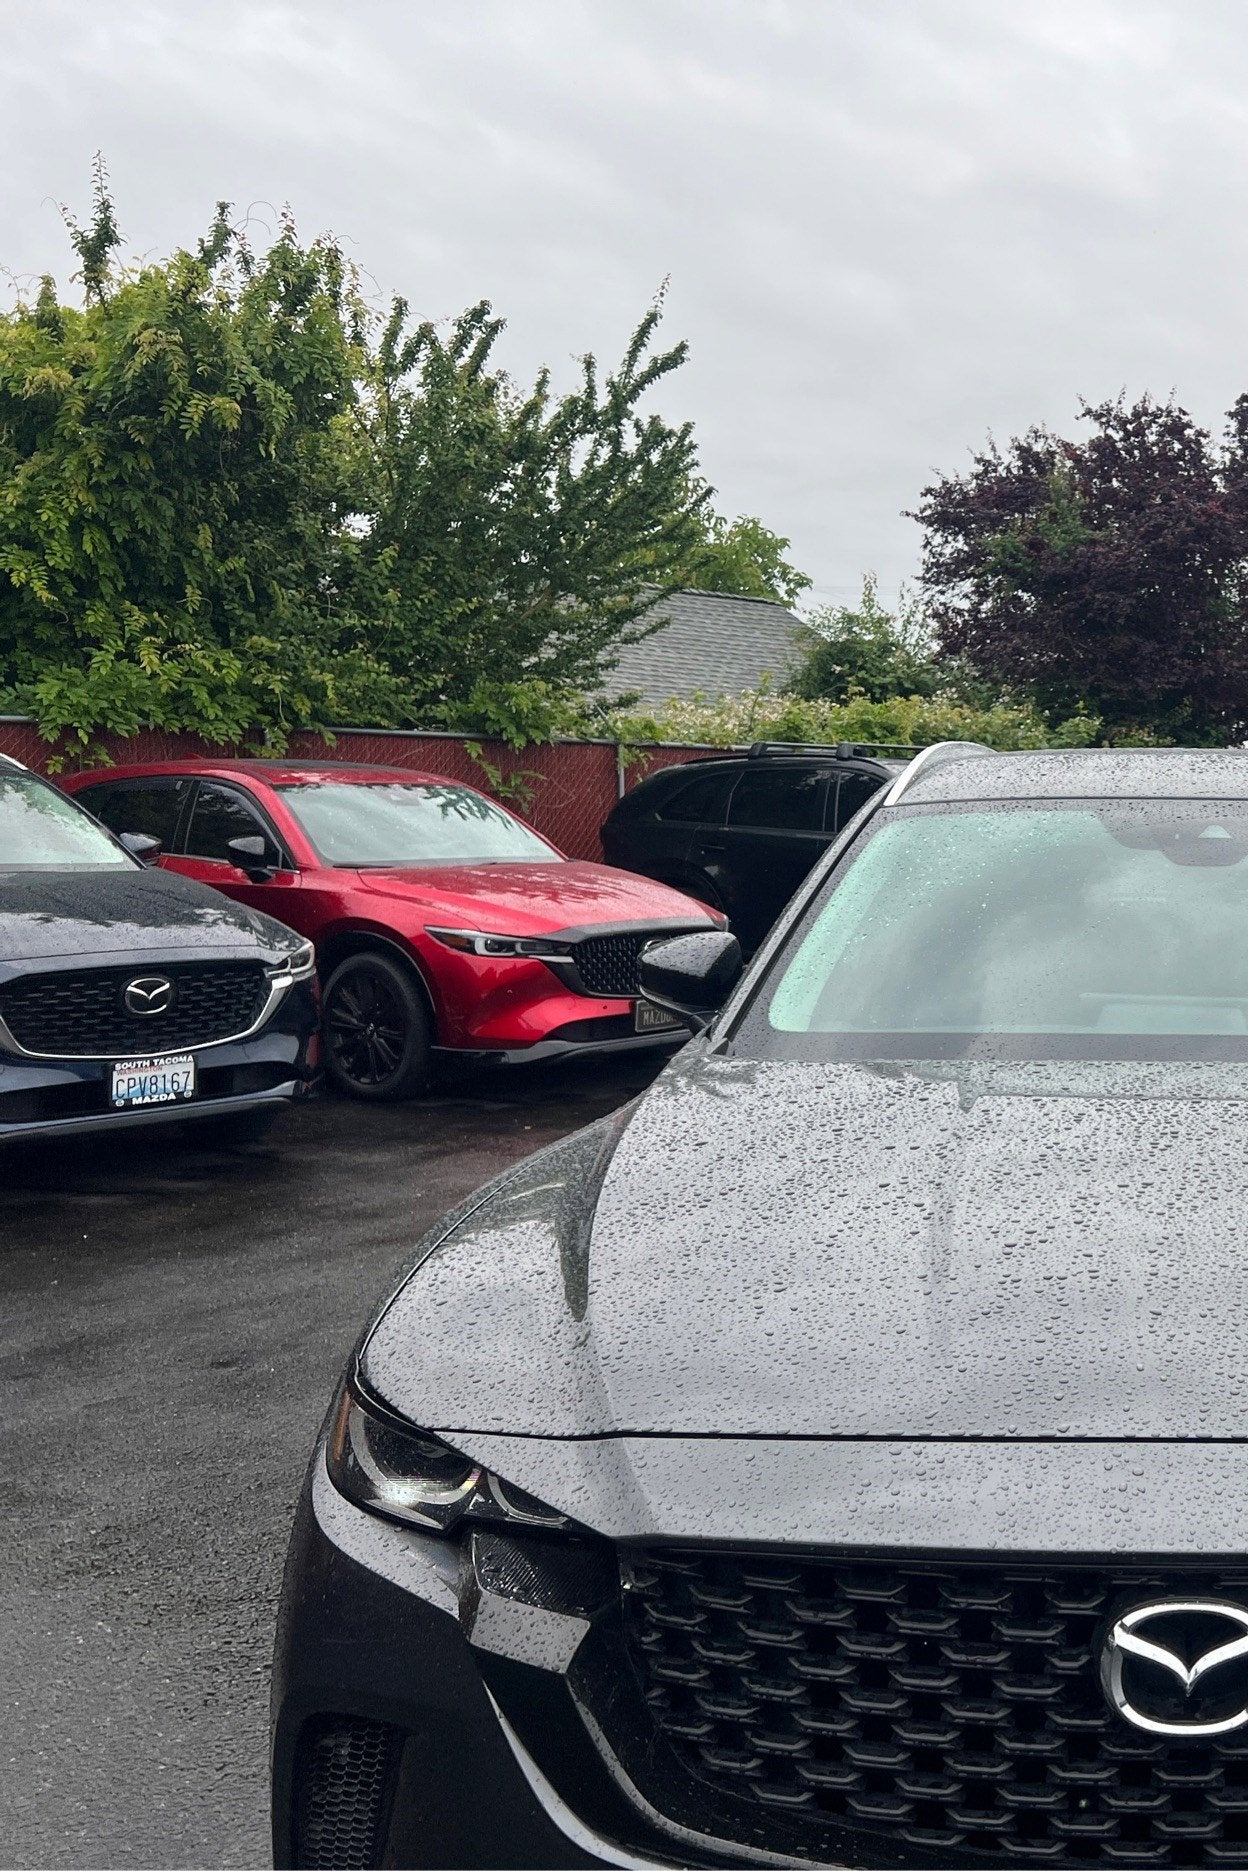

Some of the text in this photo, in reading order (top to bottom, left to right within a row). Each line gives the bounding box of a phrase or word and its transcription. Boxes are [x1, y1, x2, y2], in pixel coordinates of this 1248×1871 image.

[115, 1054, 194, 1071] SOUTH TACOMA
[116, 1065, 163, 1076] WASHINGTON
[116, 1070, 191, 1099] CPV8167
[132, 1092, 176, 1105] MAZDA
